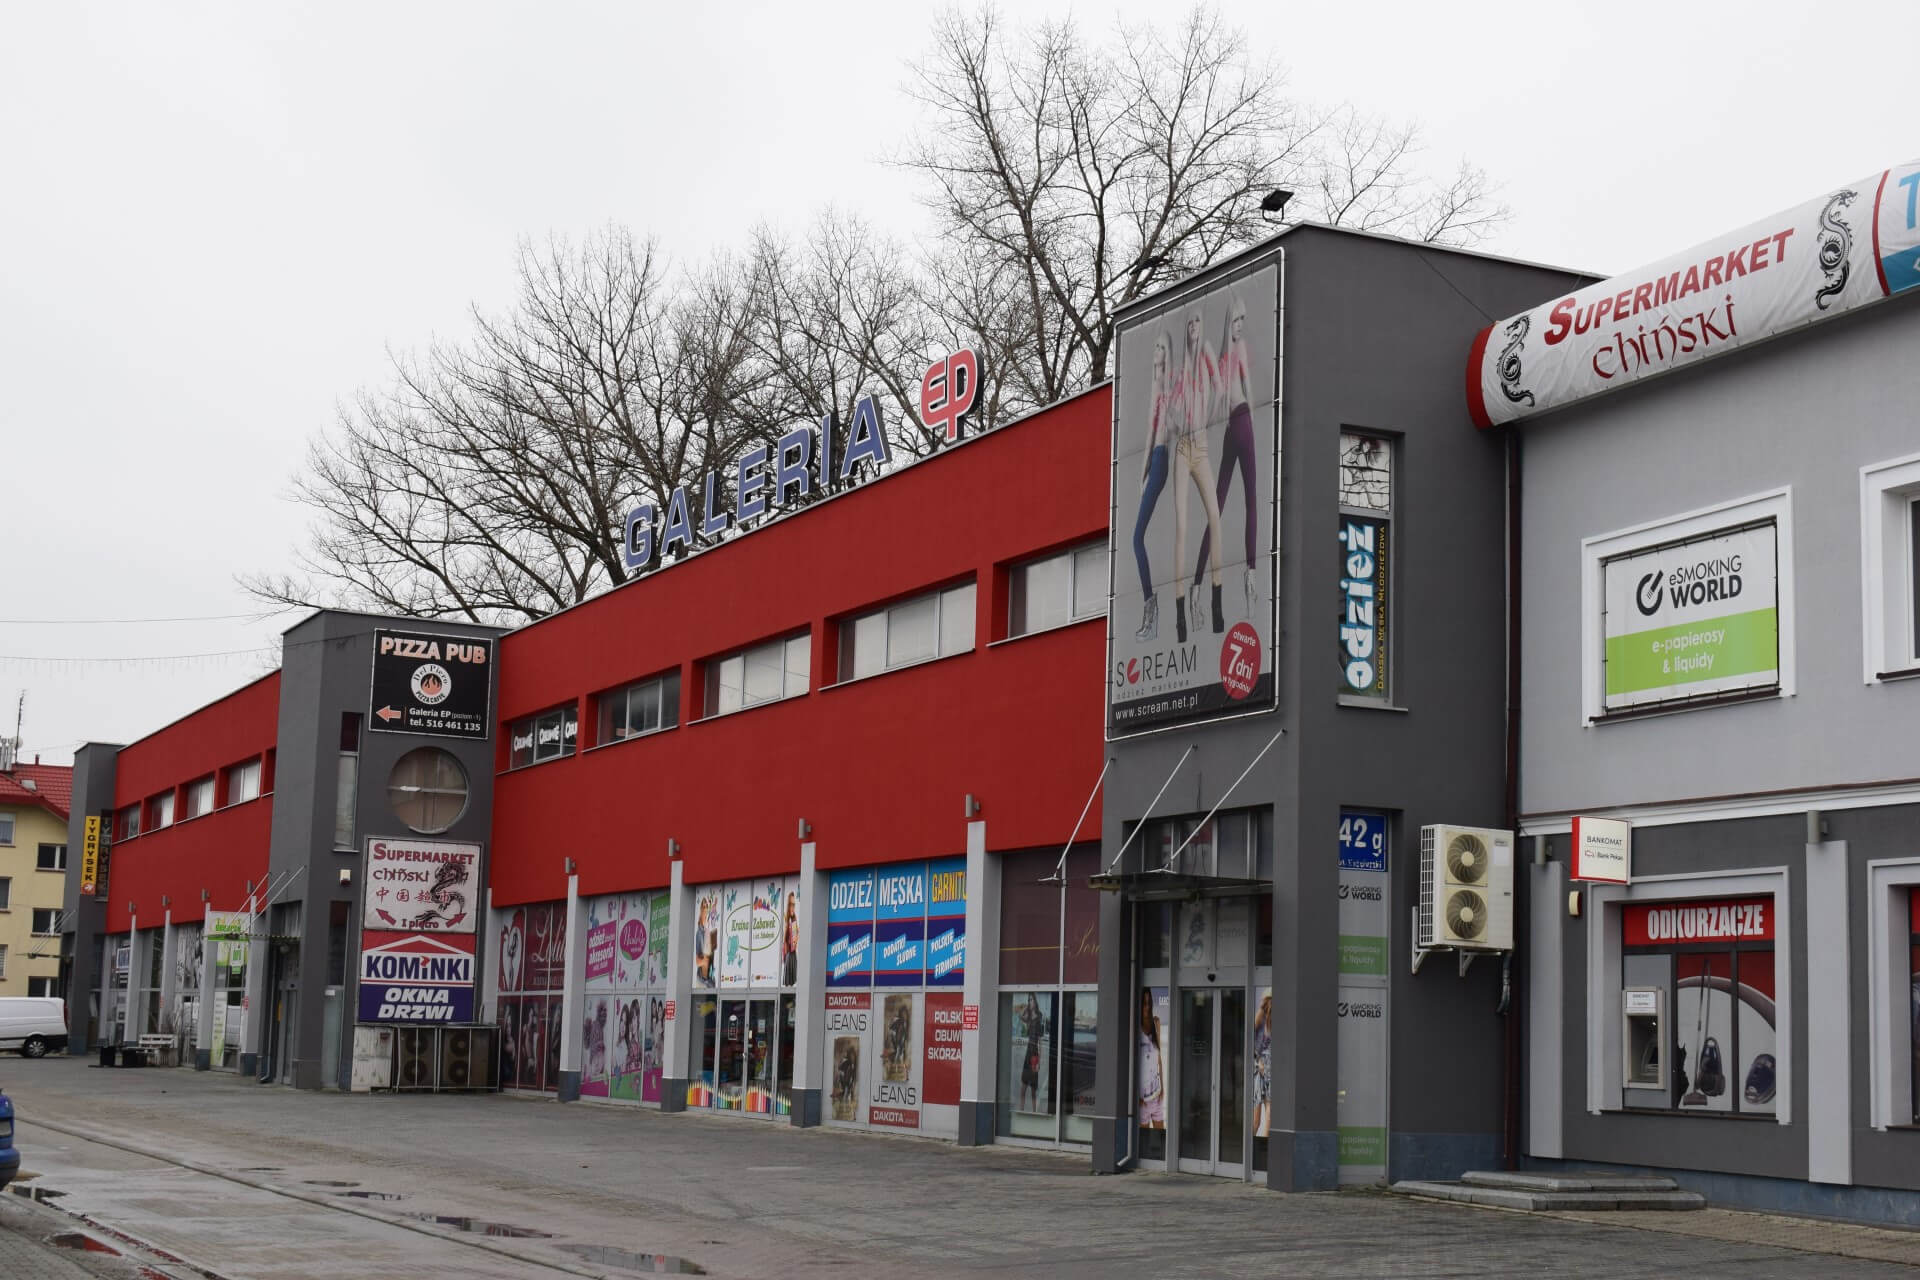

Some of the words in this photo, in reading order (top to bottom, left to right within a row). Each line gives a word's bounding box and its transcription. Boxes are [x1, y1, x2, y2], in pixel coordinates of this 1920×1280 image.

[1543, 228, 1796, 347] SUPERMARKET
[1593, 293, 1739, 380] chiński
[624, 394, 889, 570] GALERIA
[1669, 555, 1743, 586] eSMOKING
[1669, 574, 1743, 609] WORLD
[1338, 522, 1375, 690] odzież
[380, 636, 441, 660] PIZZA
[445, 643, 486, 664] PUB
[1232, 631, 1256, 647] otwarte
[1652, 627, 1726, 655] e-papierosy
[1116, 644, 1197, 687] SCREAM
[1228, 643, 1243, 675] 7
[1236, 658, 1254, 680] dni
[1663, 659, 1672, 674] &
[1674, 652, 1715, 674] liquidy
[409, 707, 439, 718] Galeria
[440, 710, 451, 718] EP
[1115, 692, 1198, 721] www.scream.net.pl
[409, 718, 424, 727] tel.
[426, 719, 443, 728] 516
[445, 721, 461, 730] 461
[464, 722, 481, 731] 135
[84, 818, 97, 881] TYGRYSEK
[1339, 818, 1368, 848] 42
[1372, 833, 1383, 857] g
[1587, 835, 1622, 846] BANKOMAT
[373, 843, 475, 865] SUPERMARKET
[831, 873, 873, 910] ODZIEŻ
[879, 874, 924, 913] MĘSKA
[1351, 891, 1382, 901] WORLD
[1647, 904, 1764, 940] ODKURZACZE
[384, 986, 449, 1004] OKNA
[828, 995, 857, 1007] DAKOTA
[377, 1003, 454, 1021] DRZWI
[826, 1013, 867, 1032] JEANS
[1351, 1009, 1382, 1018] WORLD
[873, 1085, 916, 1106] JEANS
[873, 1110, 904, 1123] DAKOTA
